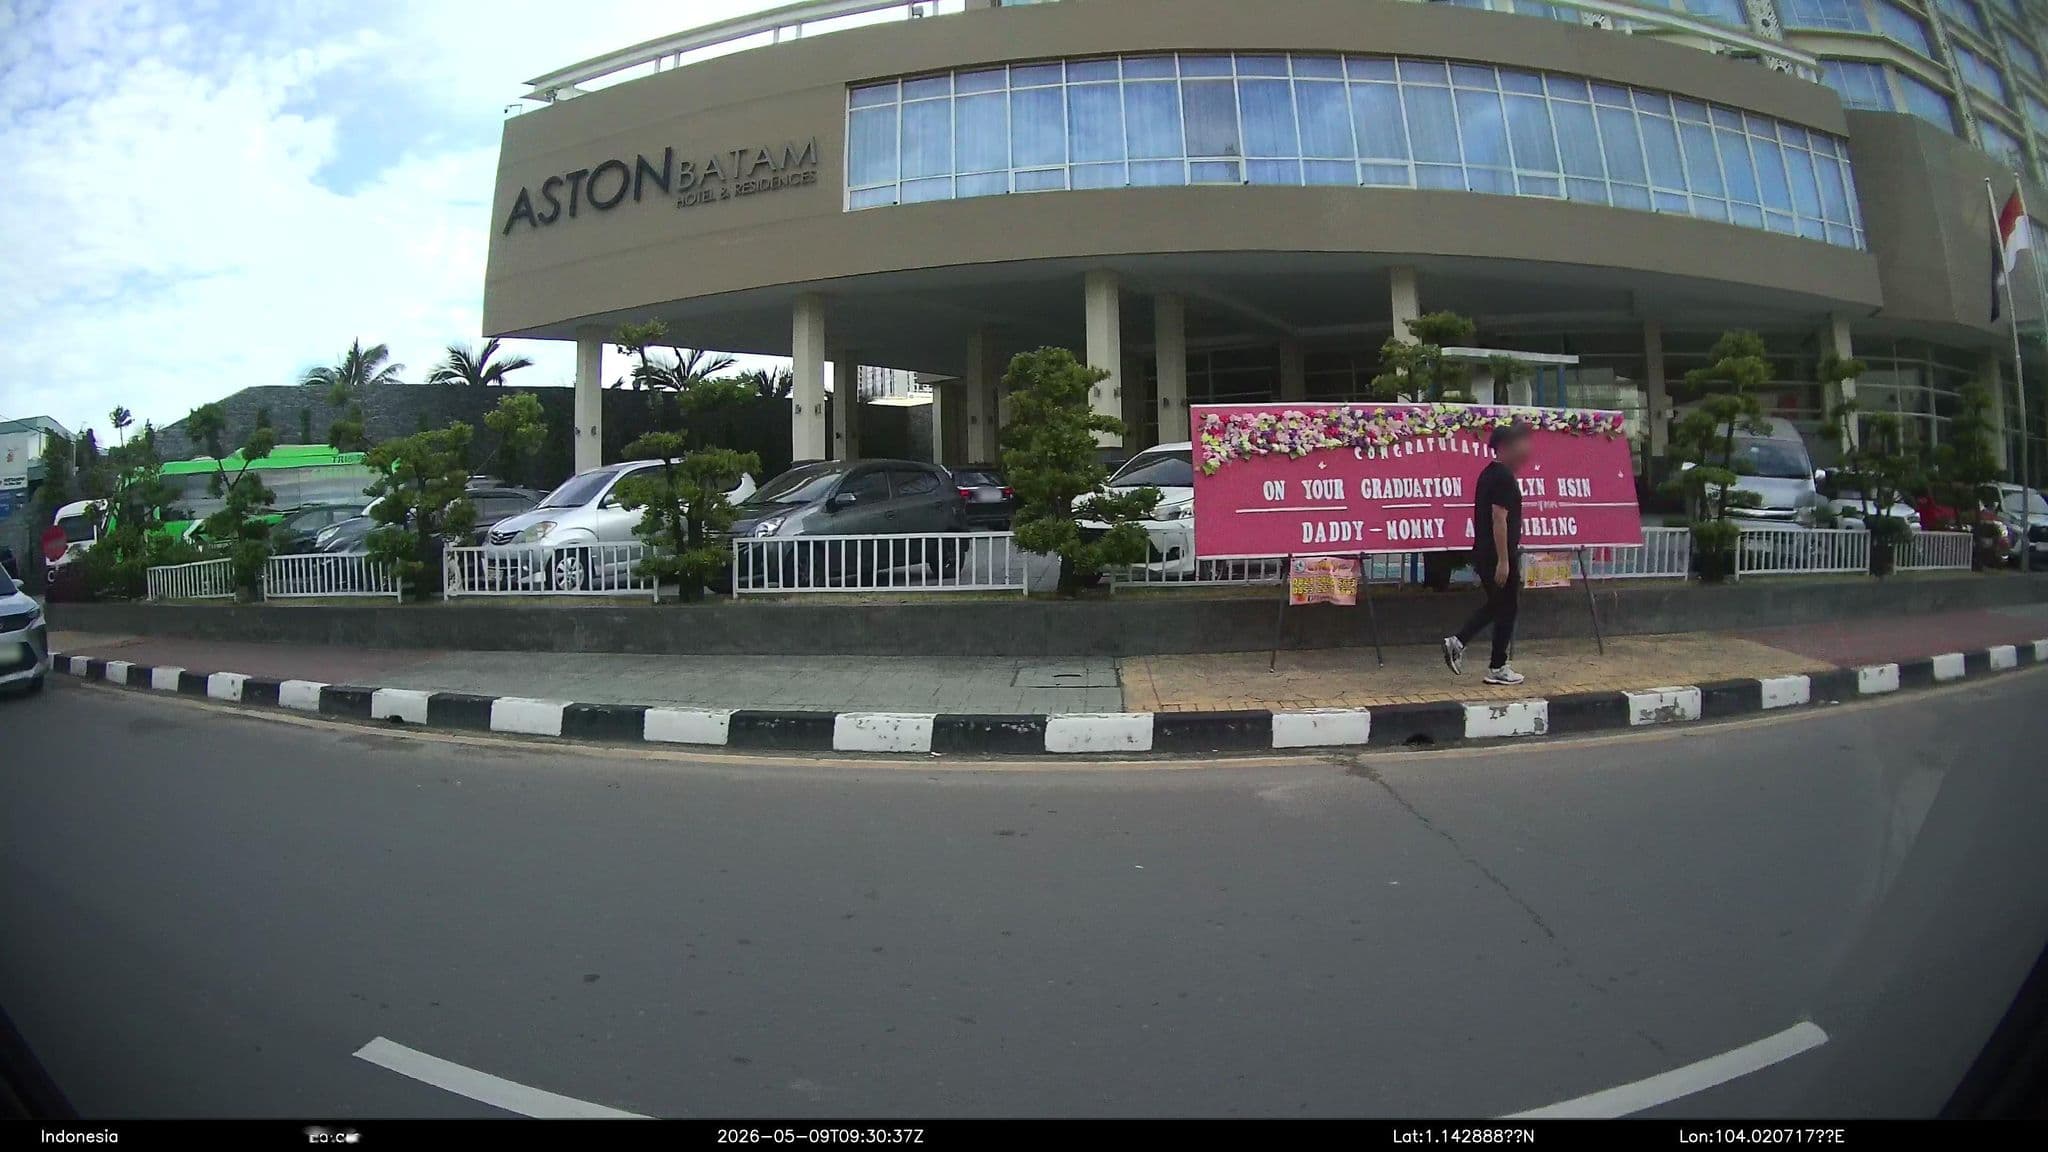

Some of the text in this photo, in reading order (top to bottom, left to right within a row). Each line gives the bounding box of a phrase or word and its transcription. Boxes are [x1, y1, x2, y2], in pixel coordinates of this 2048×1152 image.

[502, 136, 817, 236] ASTON BATAM
[676, 170, 817, 209] HOTEL & RESIDENCES
[1263, 477, 1592, 501] ON YOUR GRADUATION LYN HSIN
[1302, 520, 1364, 543] DADDY
[1386, 518, 1445, 540] MOMMY
[1520, 517, 1578, 538] IBLING
